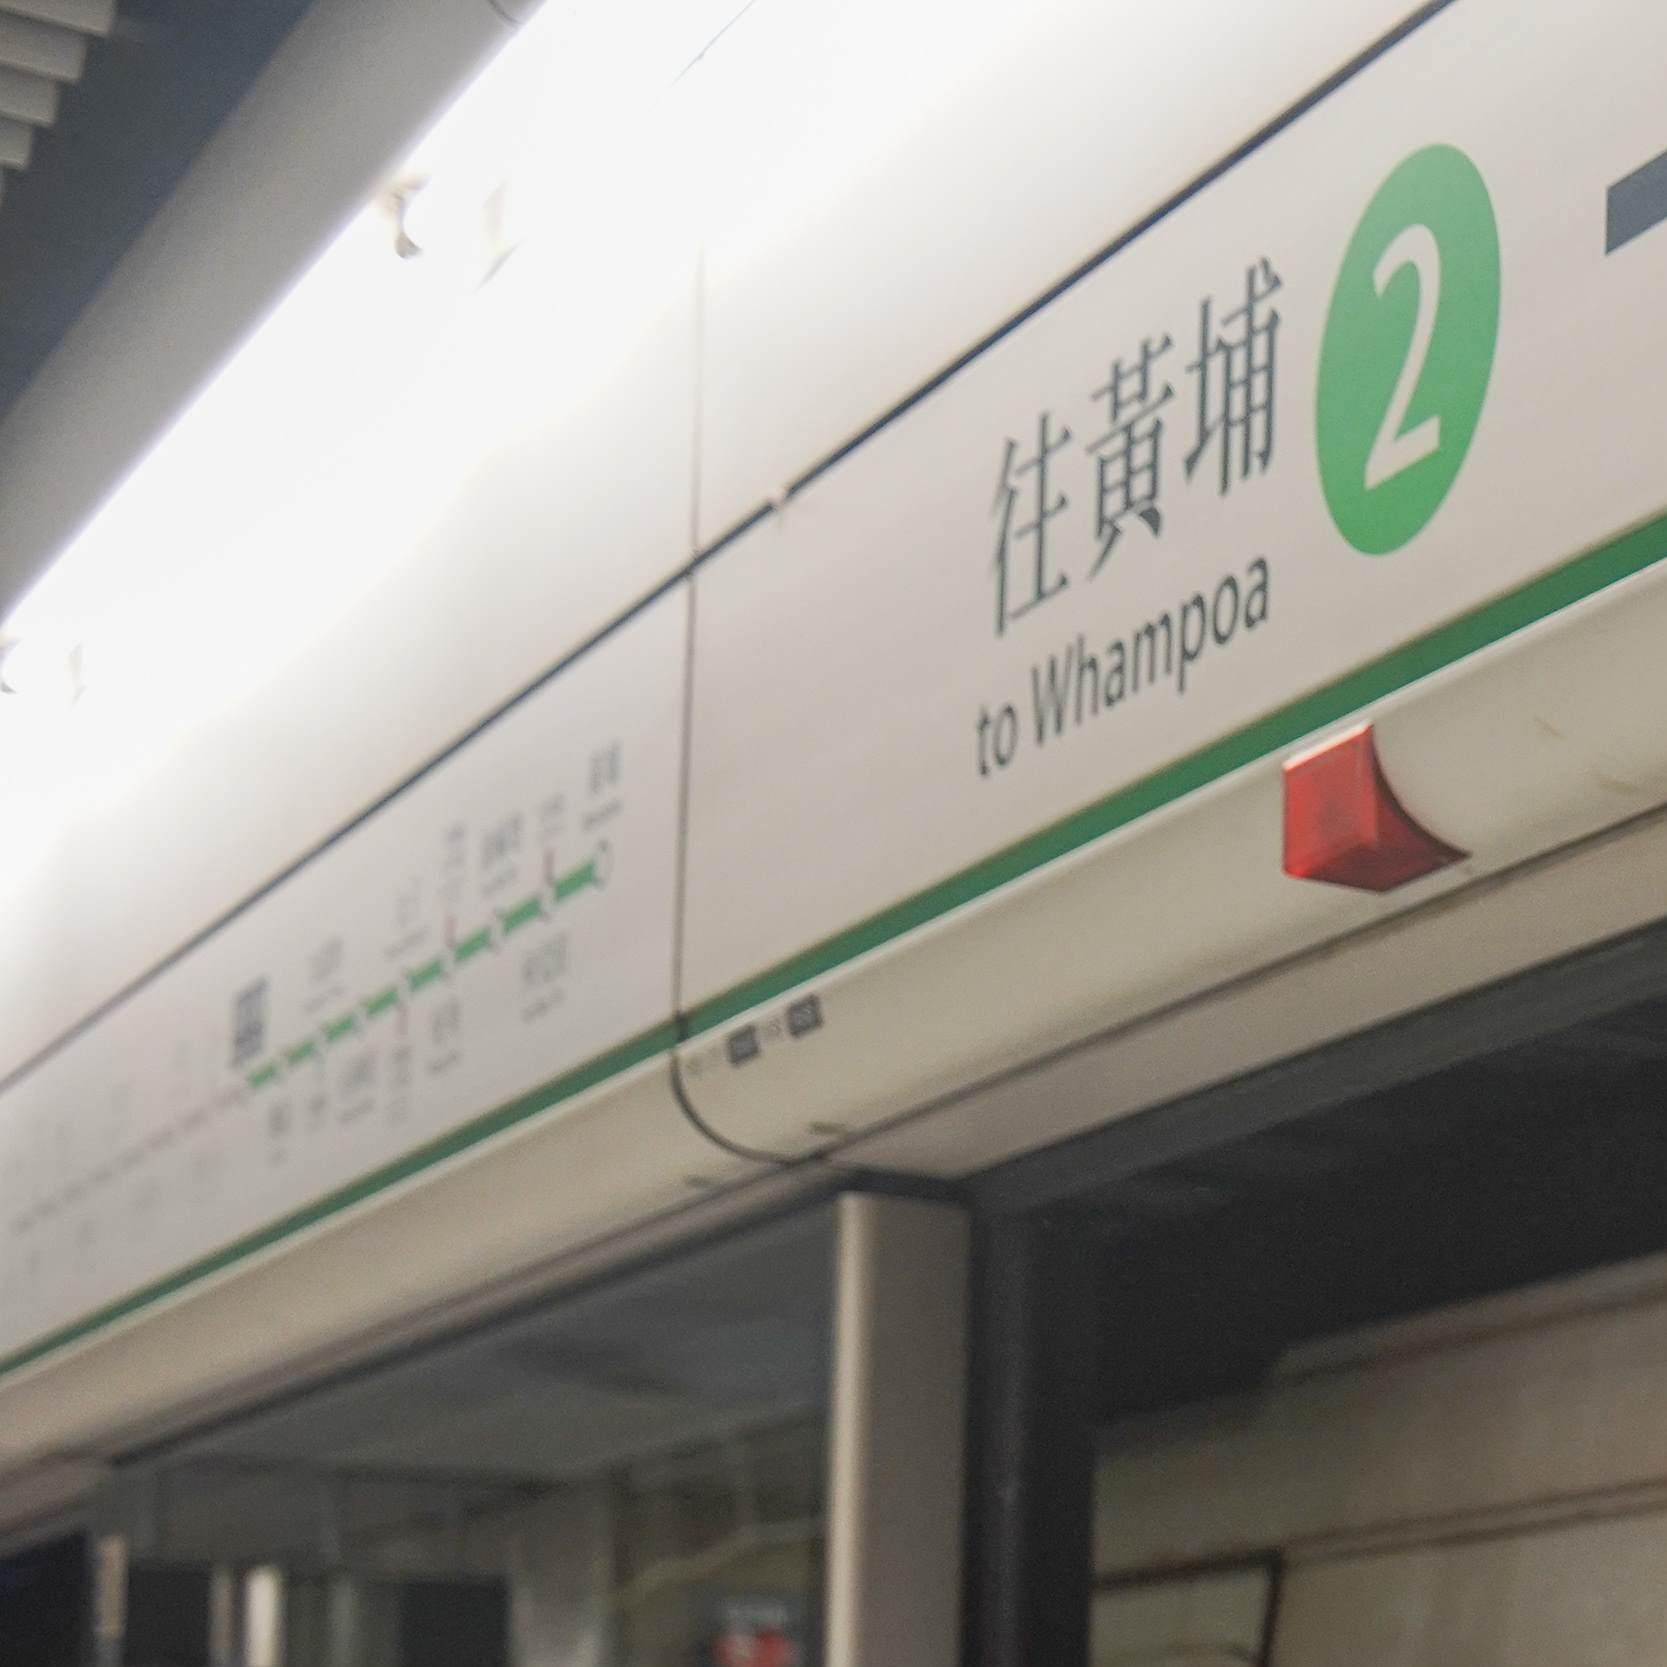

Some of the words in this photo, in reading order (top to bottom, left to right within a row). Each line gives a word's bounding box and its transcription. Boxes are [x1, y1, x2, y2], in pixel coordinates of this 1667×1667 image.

[988, 256, 1283, 638] 往黃埔
[1364, 223, 1441, 492] 2
[975, 704, 1018, 778] to
[1029, 556, 1270, 750] Whampoa
